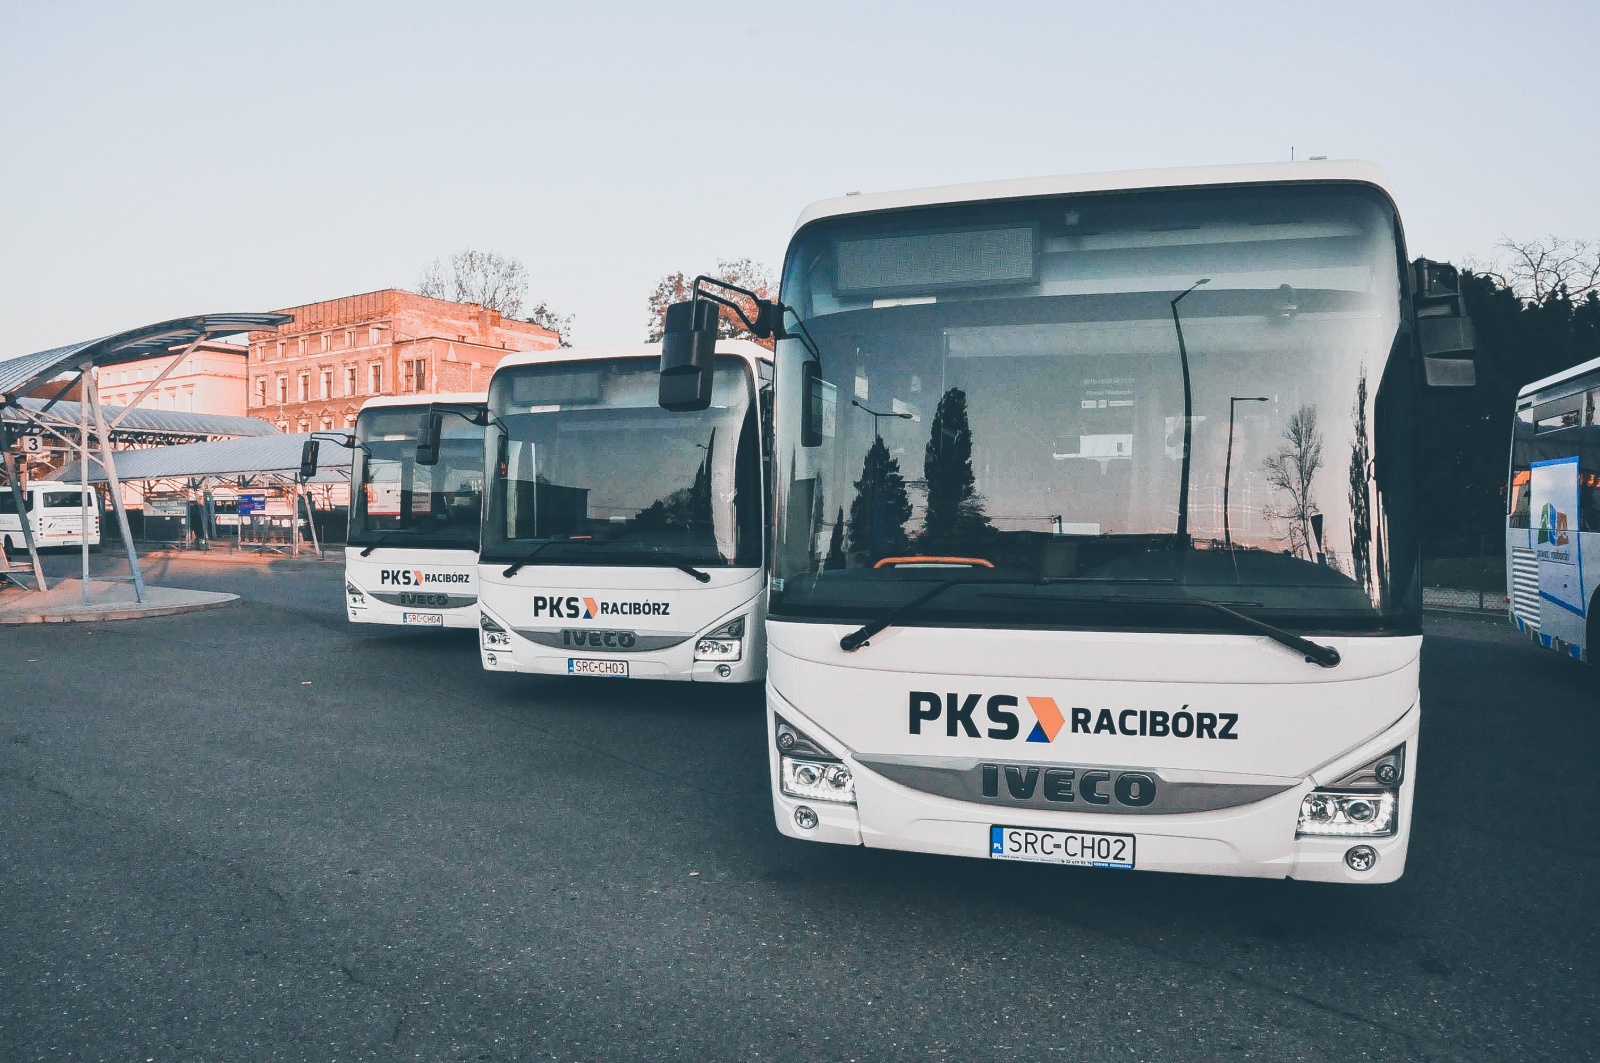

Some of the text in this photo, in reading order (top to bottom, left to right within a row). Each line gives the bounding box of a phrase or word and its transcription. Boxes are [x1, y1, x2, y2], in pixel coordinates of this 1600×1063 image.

[29, 438, 38, 450] 3
[381, 570, 470, 585] PKS RACIBÓRZ
[400, 593, 448, 606] IVECO
[533, 596, 670, 618] PKS RACIBÓRZ
[408, 614, 441, 623] SRC-CH04
[562, 629, 636, 648] IVECO
[575, 660, 625, 674] SRC-CH03
[909, 691, 1239, 740] PKS RACIBÓRZ
[982, 765, 1157, 807] IVECO
[1008, 831, 1126, 861] SRC-CH02
